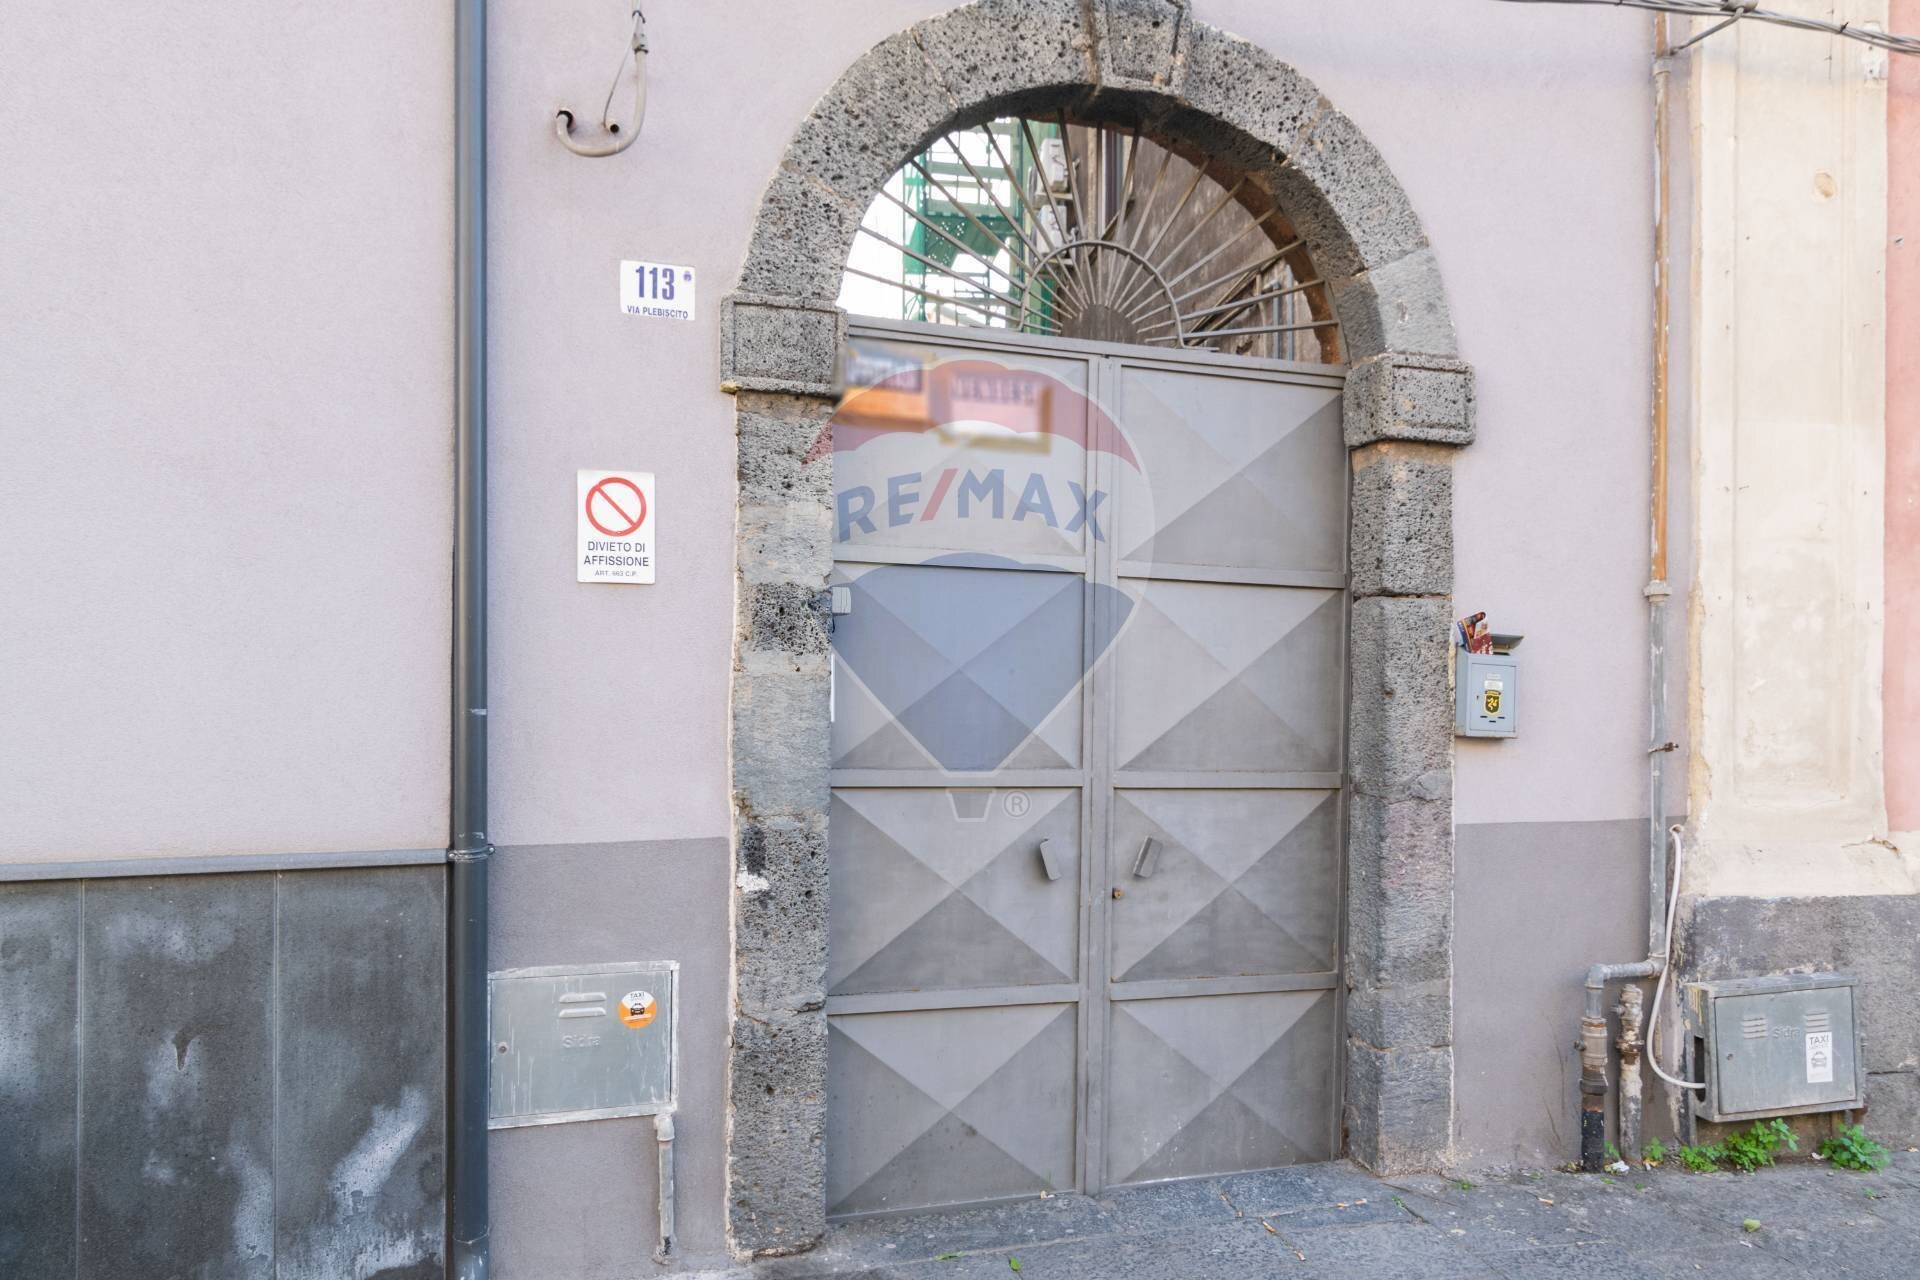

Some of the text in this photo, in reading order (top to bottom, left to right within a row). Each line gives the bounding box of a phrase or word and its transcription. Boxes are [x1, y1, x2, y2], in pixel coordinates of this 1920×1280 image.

[635, 265, 675, 300] 113
[627, 305, 688, 319] VIA PLEBISCITO
[588, 541, 645, 552] DIVIETO DI
[584, 555, 649, 566] AFFISSIONE
[1809, 1034, 1830, 1046] TAXI
